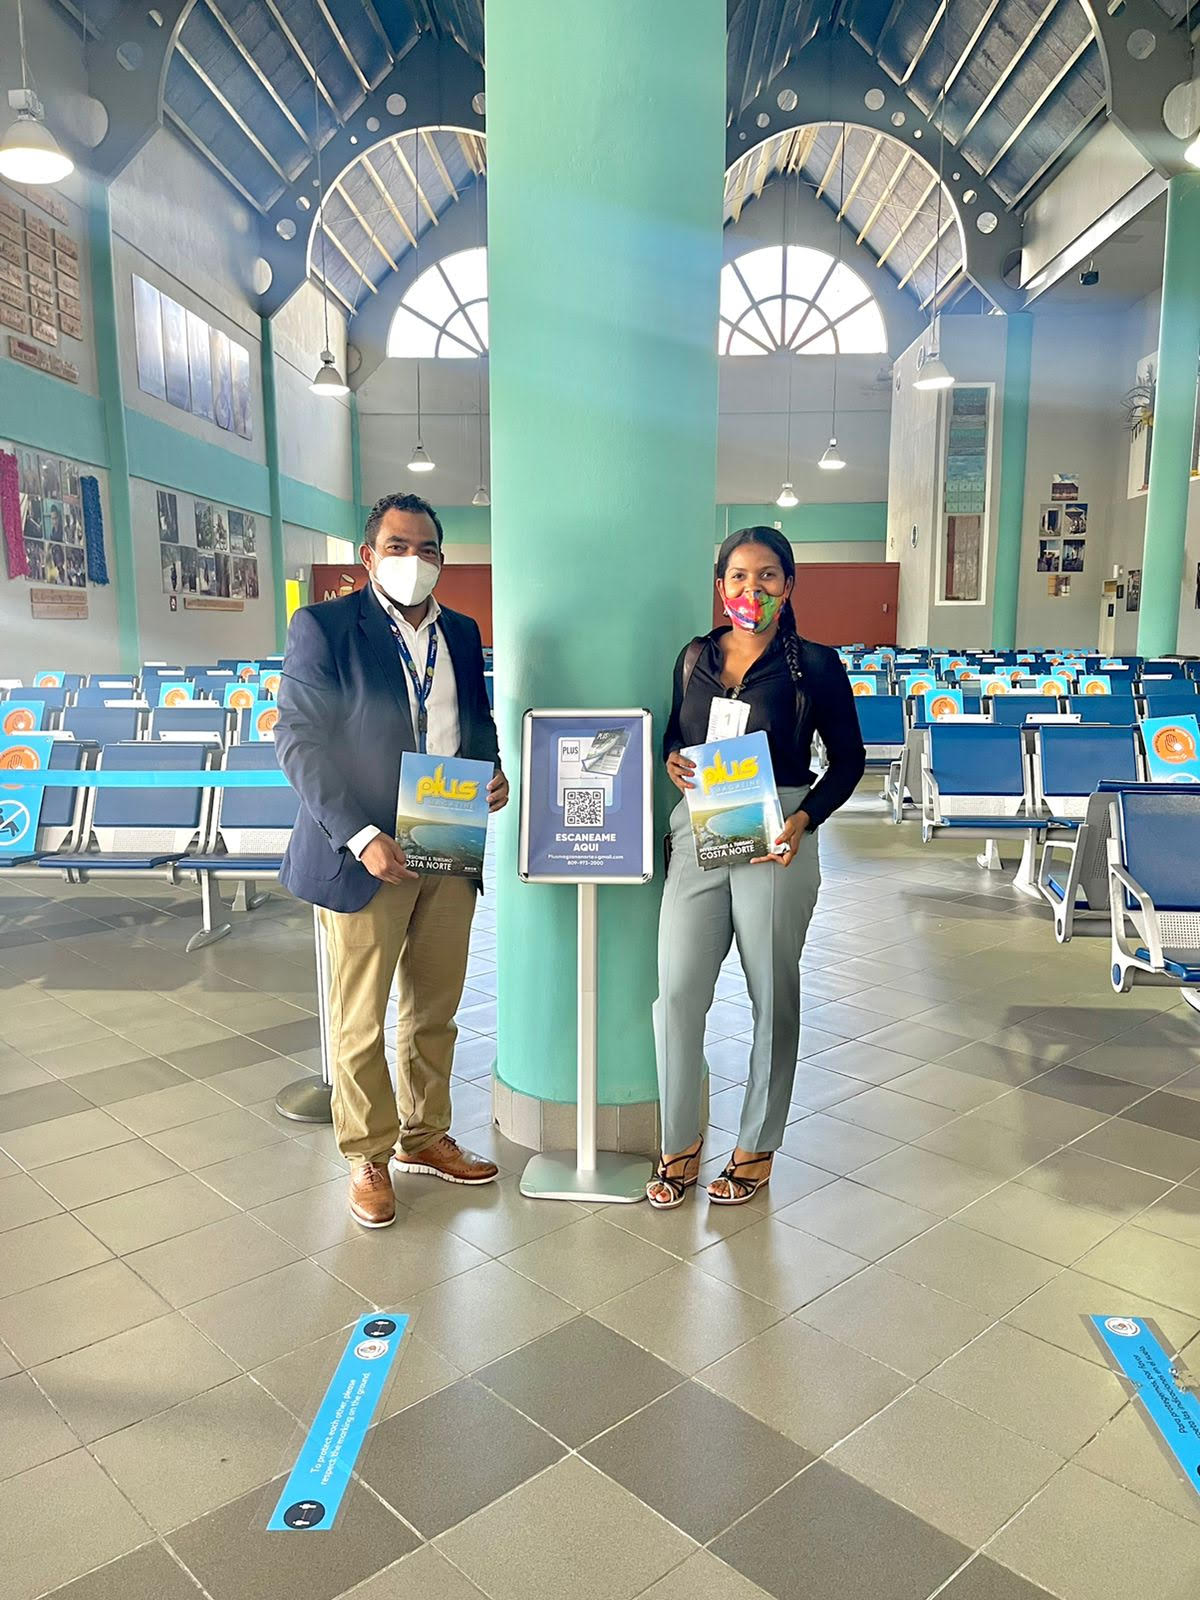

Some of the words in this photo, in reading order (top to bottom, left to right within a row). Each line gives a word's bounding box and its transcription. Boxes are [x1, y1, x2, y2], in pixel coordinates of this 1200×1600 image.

[562, 746, 579, 755] PLUS
[702, 749, 759, 796] plus
[415, 763, 480, 805] plus
[555, 833, 617, 842] ESCANEAME
[573, 843, 599, 852] AQUI
[700, 849, 728, 860] COSTA
[729, 844, 755, 855] NORTE
[406, 859, 425, 868] OSTA
[426, 861, 452, 871] NORTE
[1133, 1354, 1147, 1369] favor
[1143, 1369, 1156, 1380] por
[1158, 1374, 1185, 1410] indicaciones
[1181, 1410, 1191, 1420] las
[310, 1463, 322, 1473] To
[316, 1436, 333, 1464] protect
[329, 1419, 339, 1436] each
[343, 1379, 356, 1400] please
[321, 1457, 337, 1486] respect
[331, 1444, 342, 1457] the
[337, 1416, 355, 1444] marking
[351, 1396, 361, 1408] the
